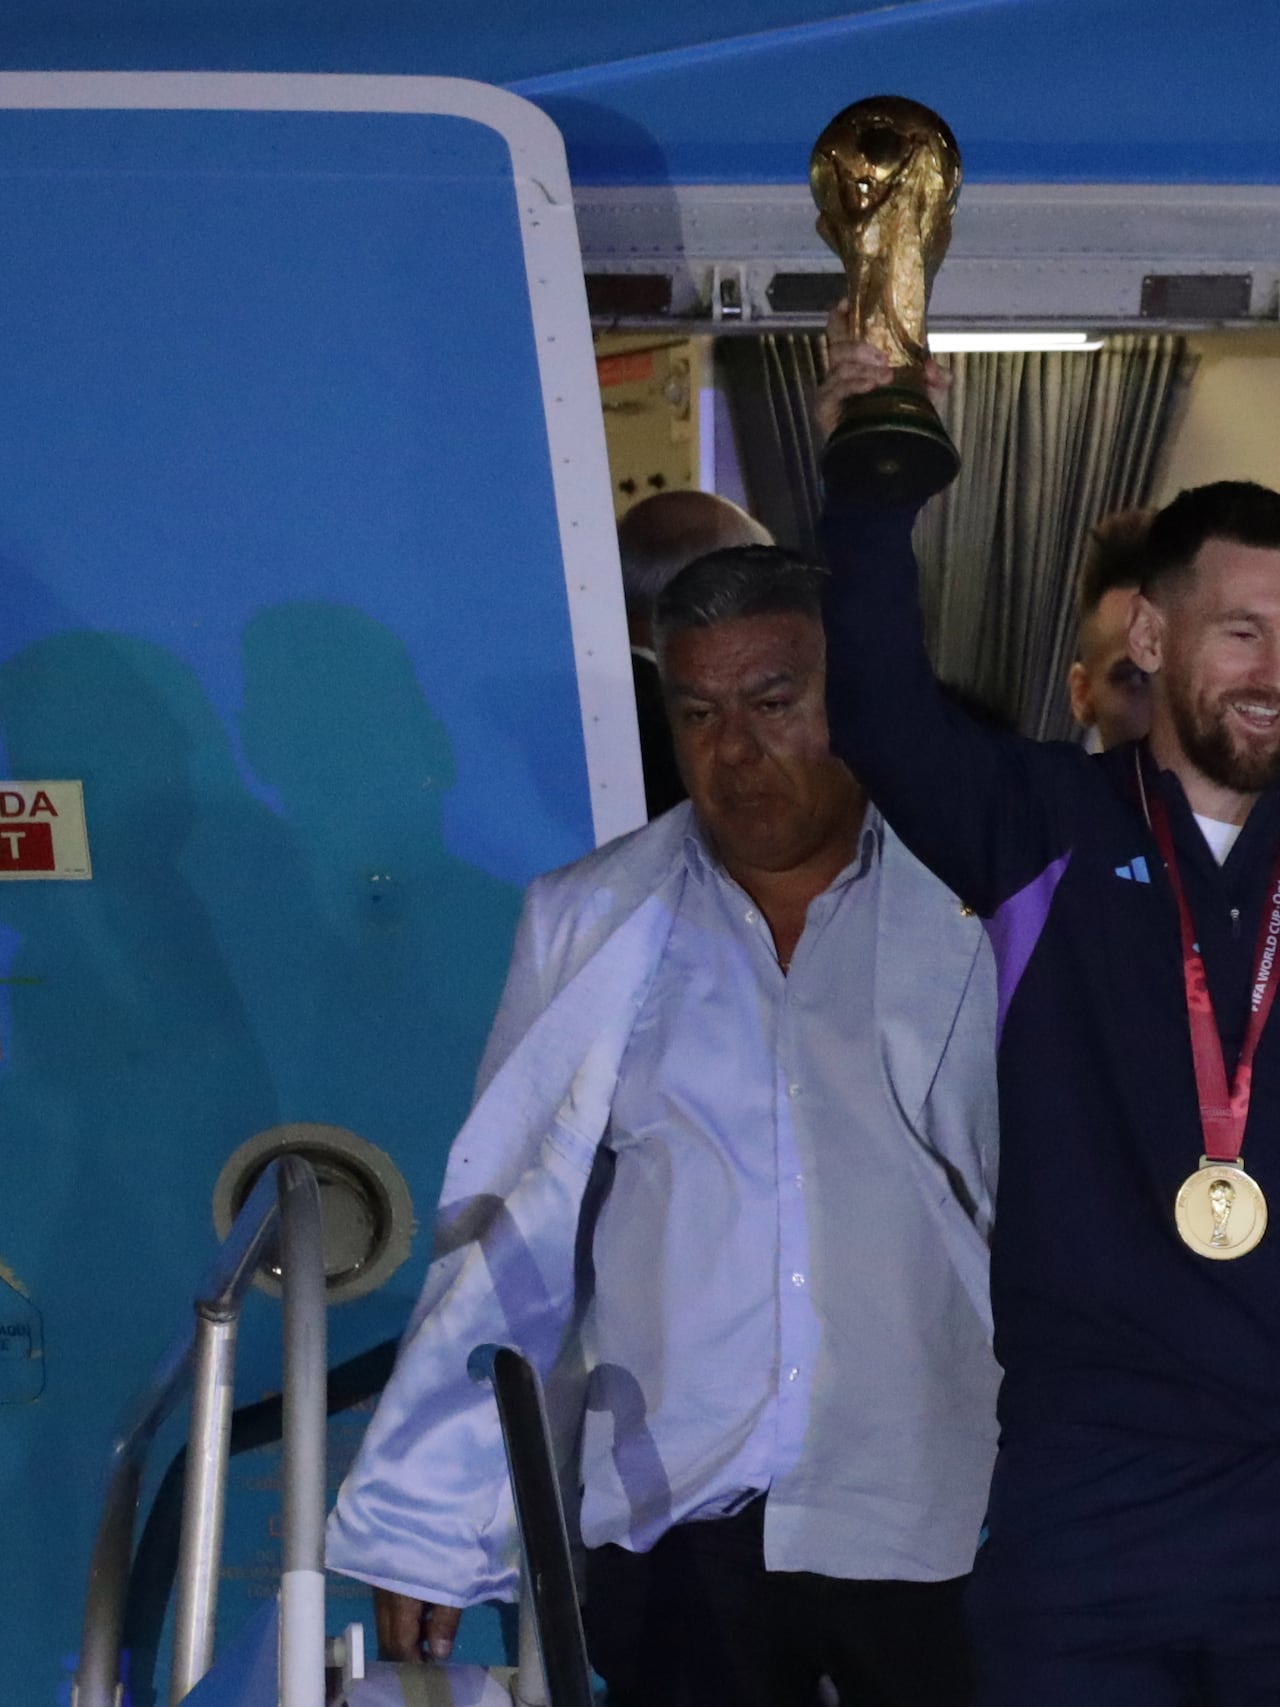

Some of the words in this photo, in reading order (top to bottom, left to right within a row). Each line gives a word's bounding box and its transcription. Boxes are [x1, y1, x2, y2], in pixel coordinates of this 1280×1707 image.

[0, 791, 58, 817] DA
[1, 831, 26, 859] T
[1257, 936, 1277, 981] WORLD
[1251, 983, 1266, 1012] FIFA
